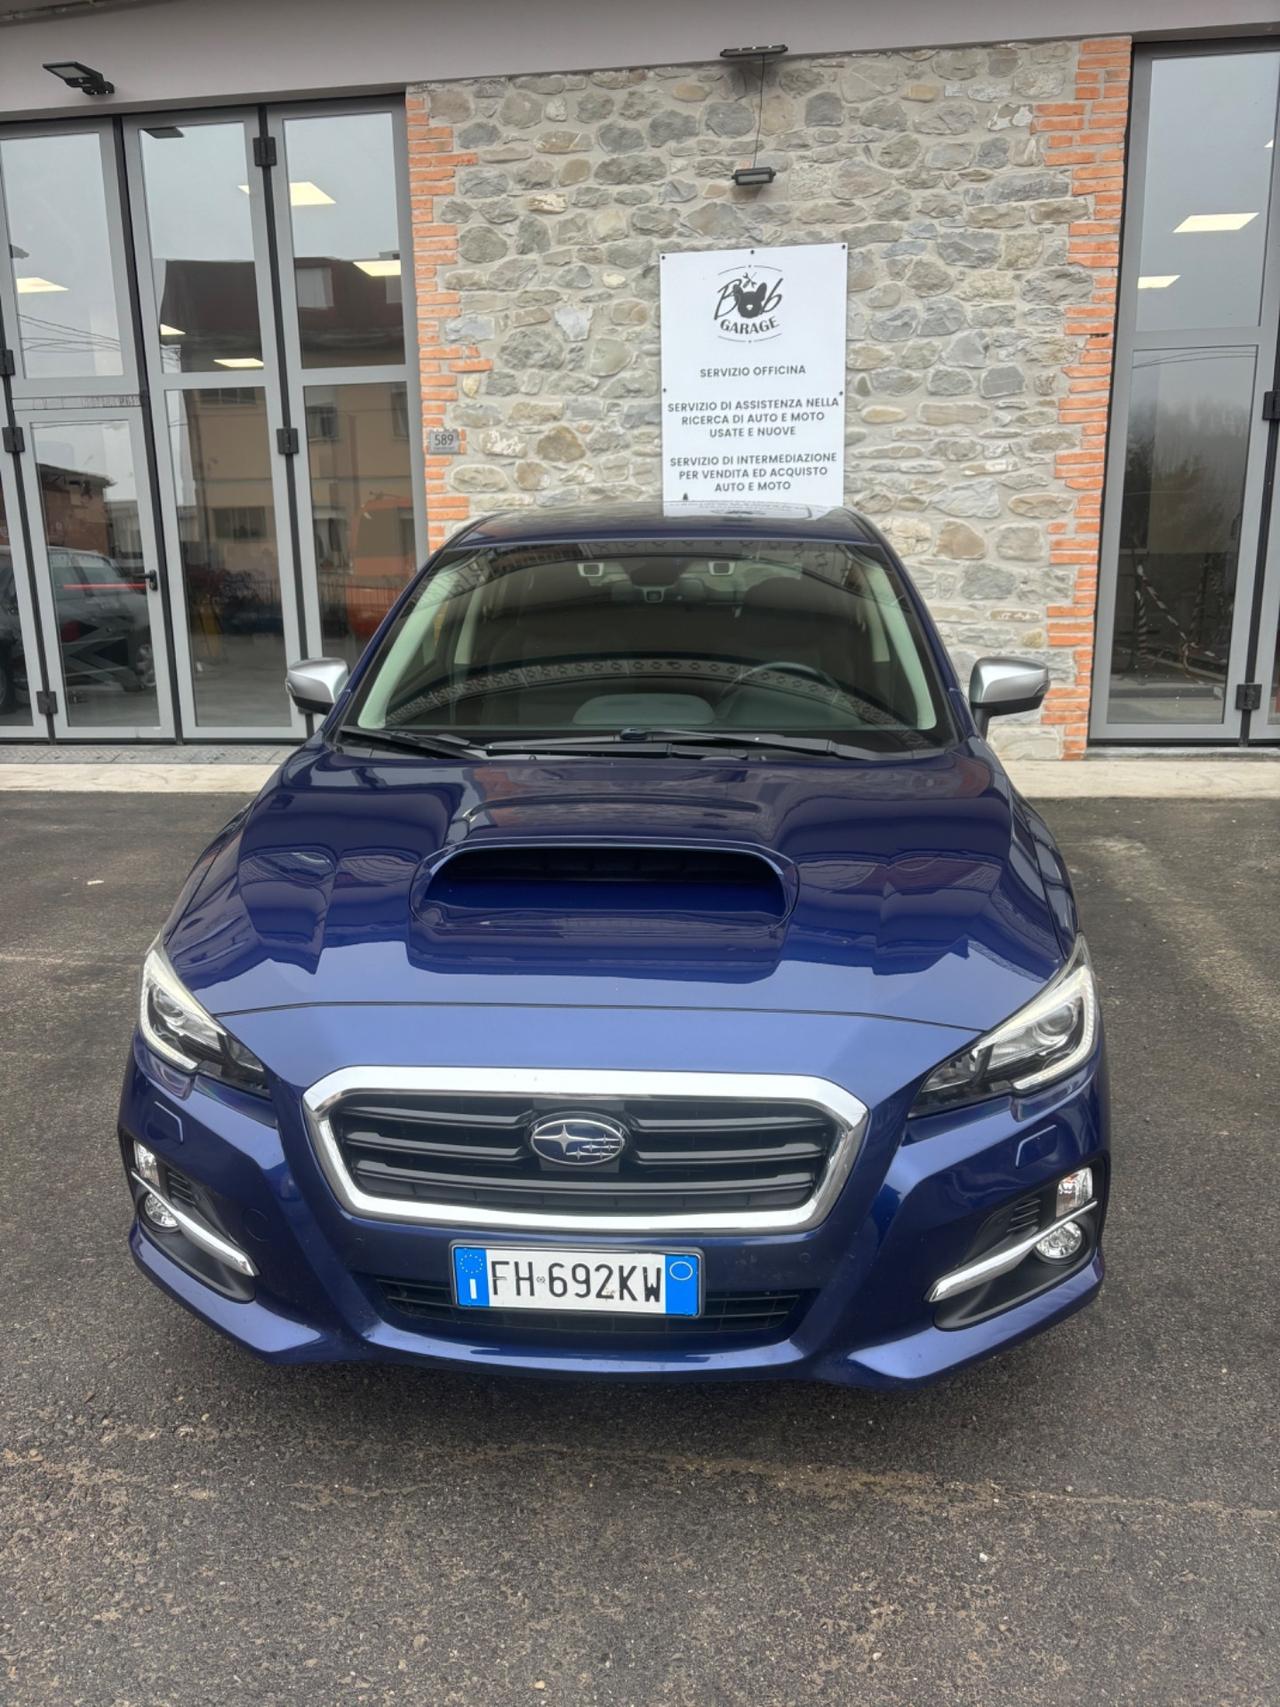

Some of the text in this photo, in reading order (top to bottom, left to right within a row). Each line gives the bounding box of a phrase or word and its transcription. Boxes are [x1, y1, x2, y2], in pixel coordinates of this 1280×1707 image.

[720, 316, 780, 335] GARAGE
[700, 365, 806, 378] SERVIZIO OFFICINA
[668, 398, 839, 412] SERVIZIO DI ASSISTENZA NELLA
[682, 412, 825, 425] RICERCA DI AUTO E MOTO
[710, 426, 796, 438] USATE E NUOVE
[434, 433, 454, 446] 589
[670, 453, 837, 467] SERVIZIO DI INTERMEDIAZIONE
[679, 467, 828, 480] PER VENDITA ED ACQUISTO
[714, 481, 791, 492] AUTO E MOTO
